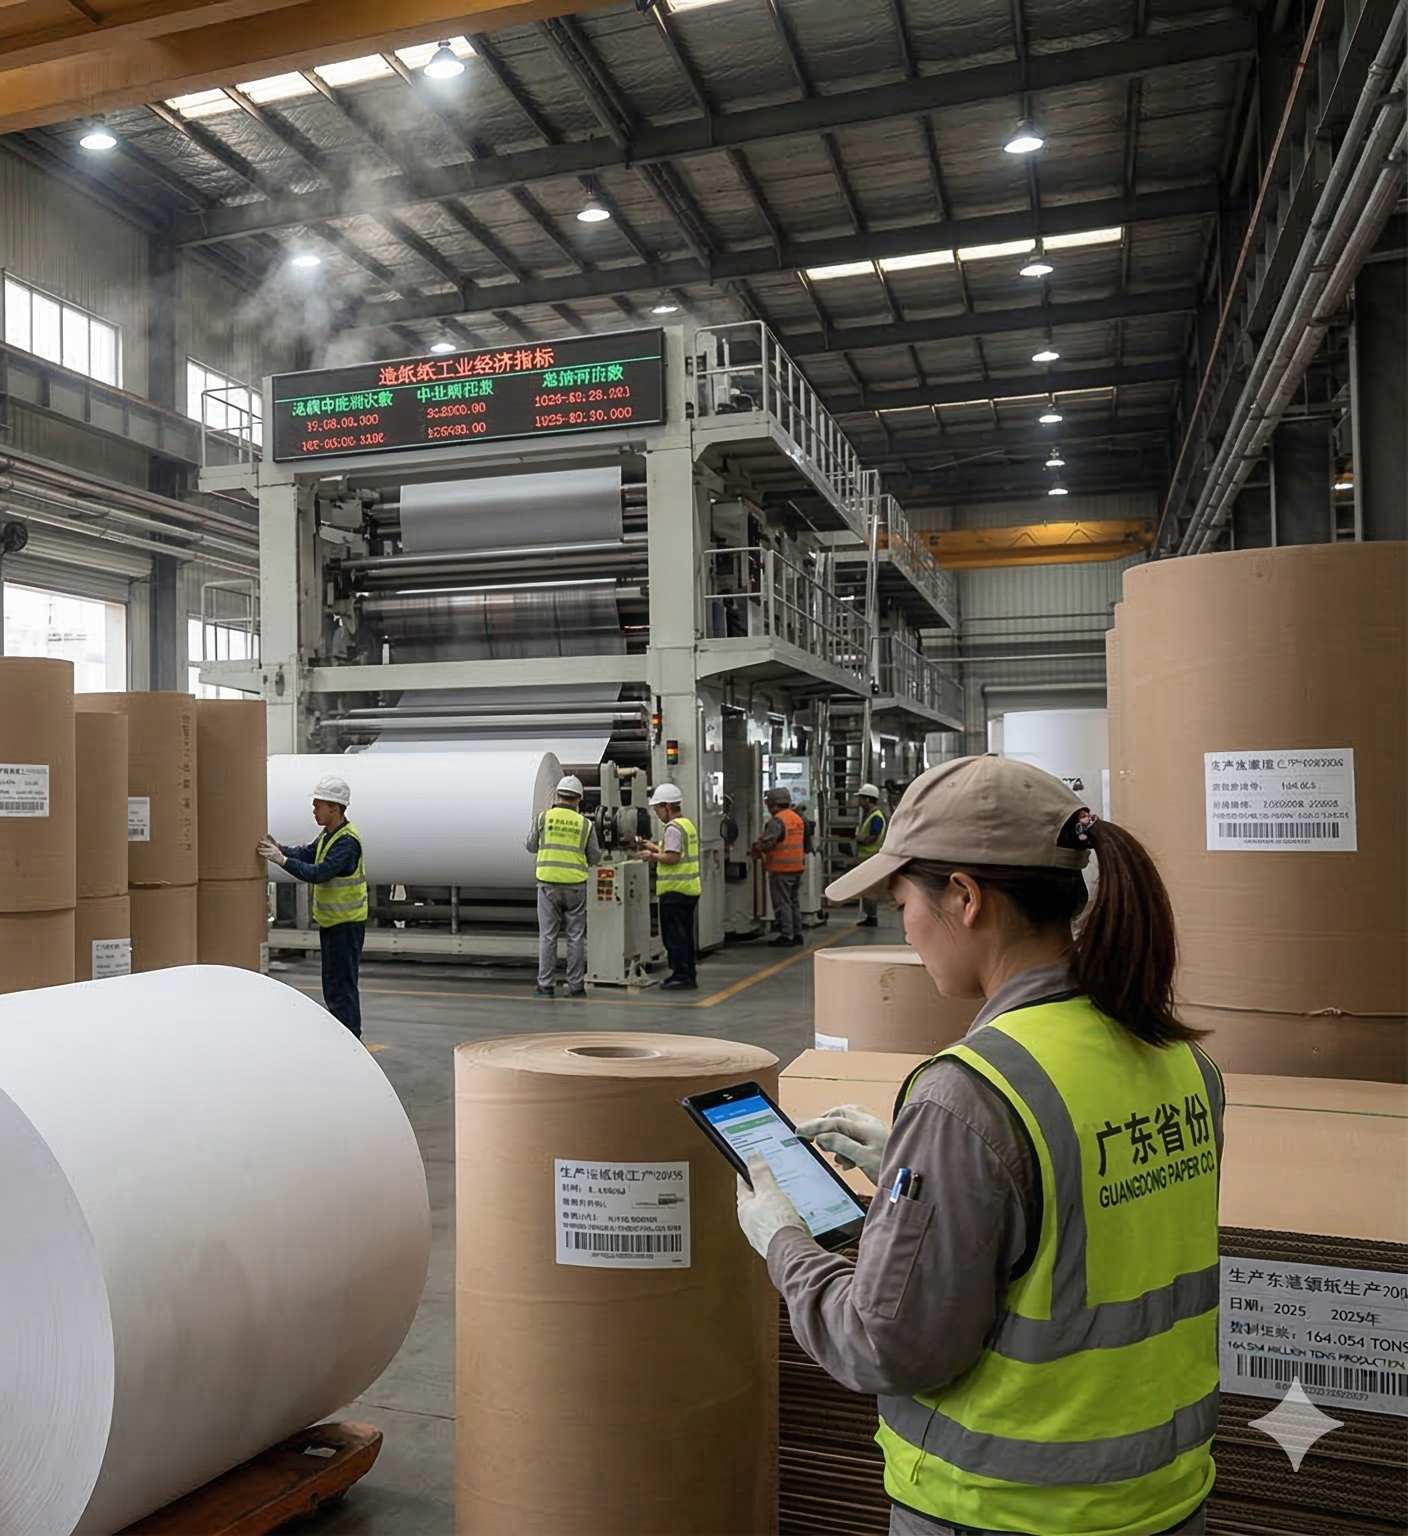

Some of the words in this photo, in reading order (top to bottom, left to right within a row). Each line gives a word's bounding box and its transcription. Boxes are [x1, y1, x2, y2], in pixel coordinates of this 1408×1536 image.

[1095, 1092, 1211, 1178] 广东省份
[1099, 1165, 1167, 1209] GUANGDONG
[1167, 1154, 1199, 1185] PAPER
[1306, 1330, 1364, 1348] 164.054
[1370, 1337, 1408, 1354] TONS
